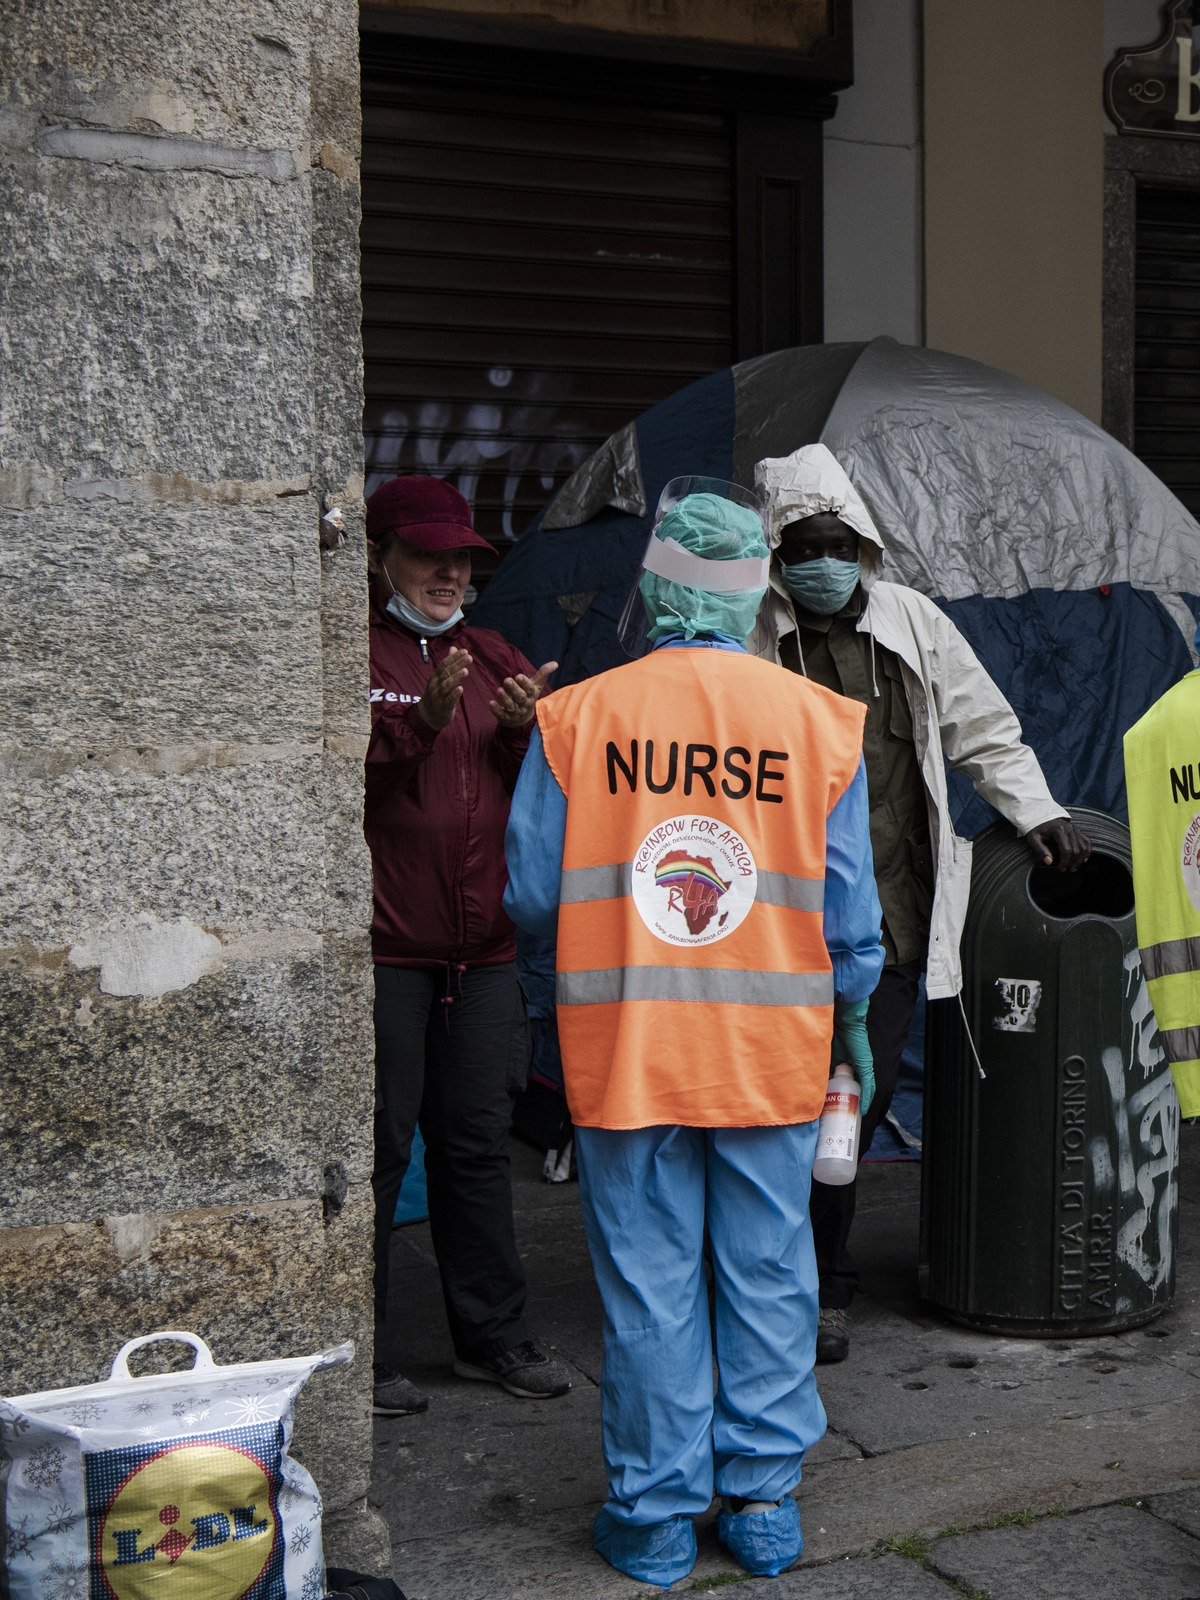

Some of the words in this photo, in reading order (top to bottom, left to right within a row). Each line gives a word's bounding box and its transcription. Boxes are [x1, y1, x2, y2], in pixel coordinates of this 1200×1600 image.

[369, 688, 421, 704] Zeus
[606, 739, 789, 804] NURSE
[635, 819, 685, 873] R@INBOW
[691, 818, 719, 837] FOR
[717, 830, 754, 876] AFRICA
[1061, 1054, 1087, 1171] TORINO
[1060, 1180, 1085, 1210] DI
